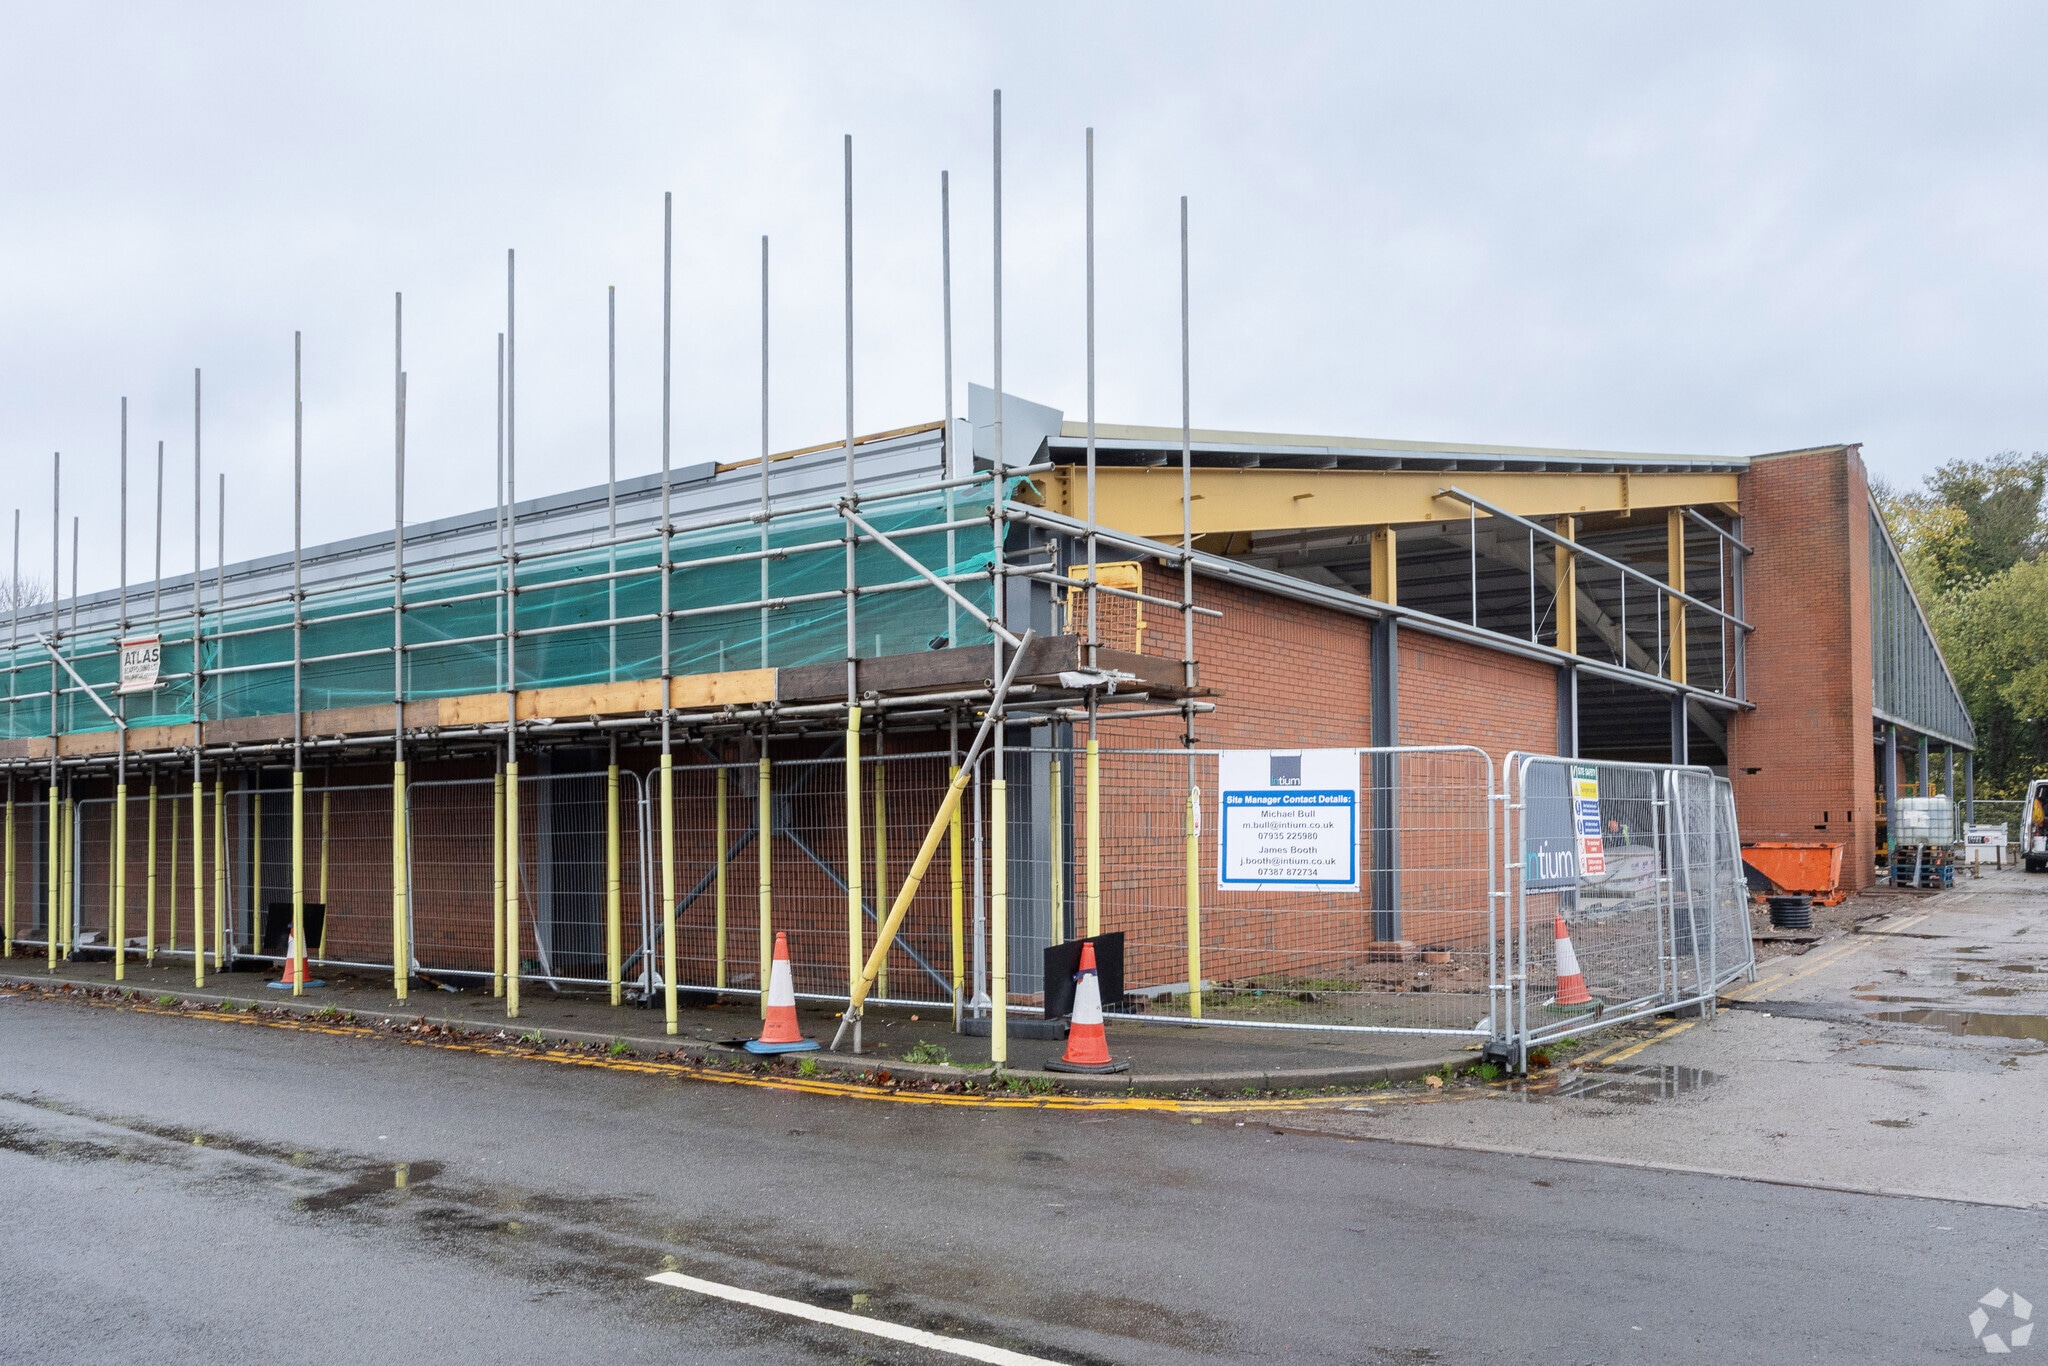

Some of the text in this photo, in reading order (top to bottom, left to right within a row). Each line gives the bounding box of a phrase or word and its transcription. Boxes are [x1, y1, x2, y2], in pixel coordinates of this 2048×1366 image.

[124, 648, 159, 667] ATLAS
[1226, 794, 1352, 806] Site Manager Contact Details:
[1260, 810, 1316, 818] Michael Bull
[1242, 821, 1335, 830] m.bull@intium.co.uk
[1257, 832, 1318, 840] 07935 225980
[1258, 846, 1318, 854] James Booth
[1240, 857, 1336, 866] j.booth@intium.co.uk
[1257, 868, 1318, 876] 07387 872734
